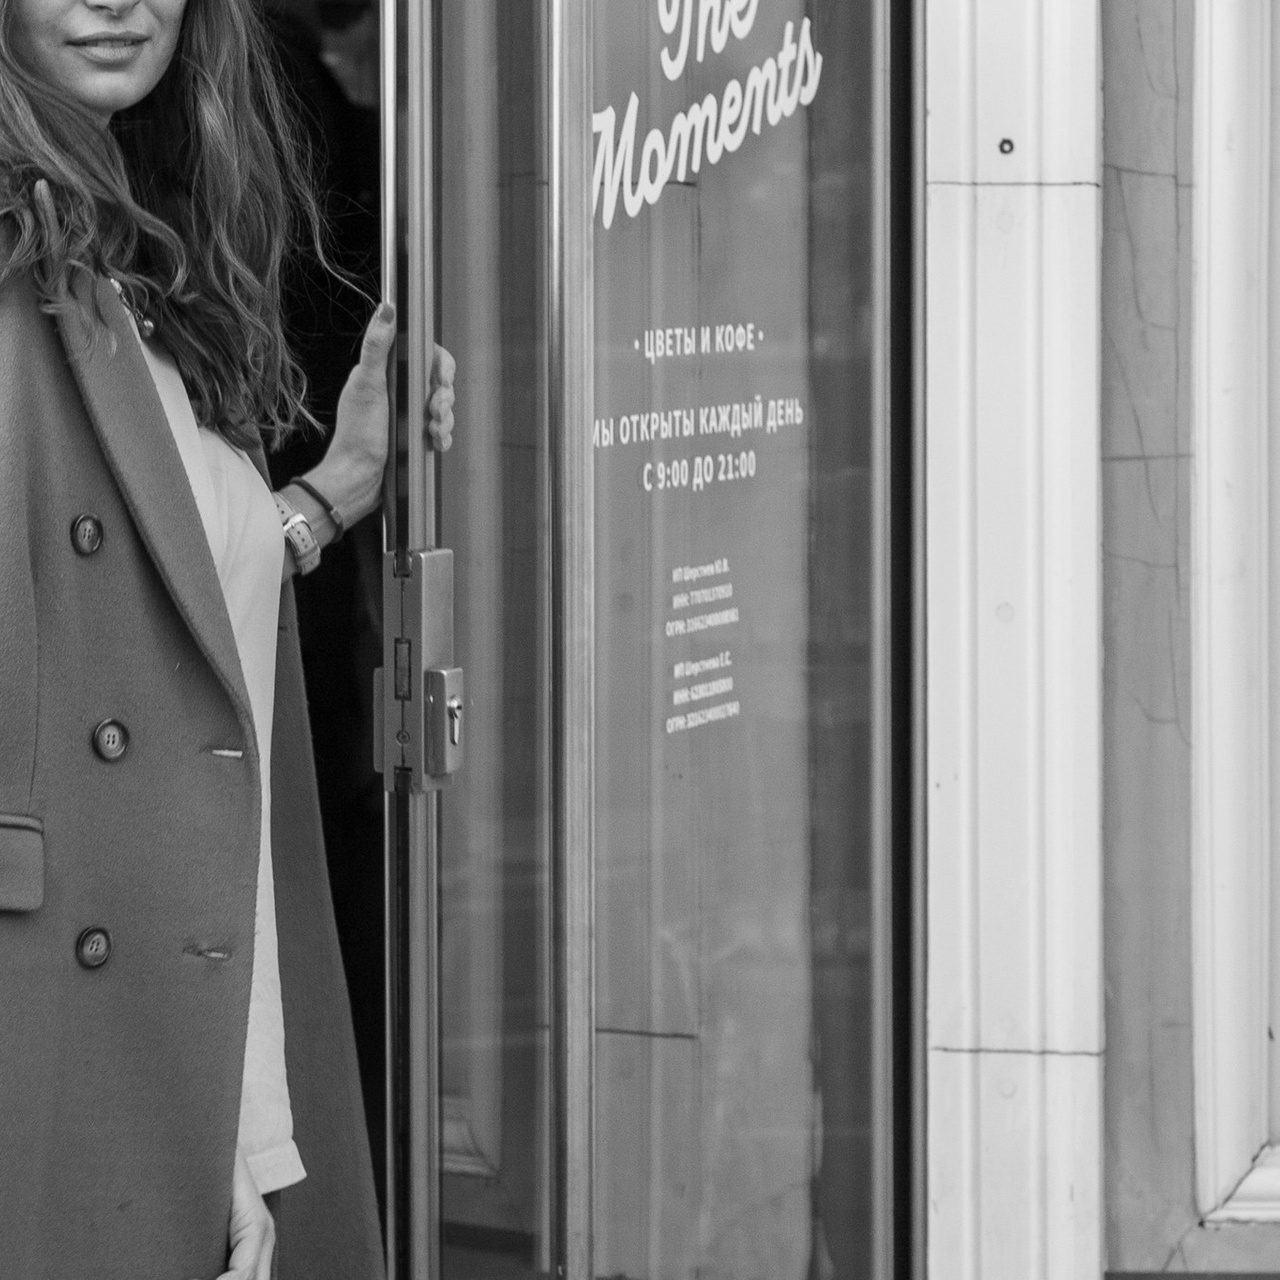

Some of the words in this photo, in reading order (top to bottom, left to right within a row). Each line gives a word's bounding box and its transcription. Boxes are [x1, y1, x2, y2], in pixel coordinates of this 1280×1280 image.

[593, 16, 823, 230] Moments
[644, 326, 696, 365] ЦВЕТЫ
[701, 325, 710, 354] И
[715, 322, 755, 353] КОФЕ
[620, 408, 695, 445] ОТКРЫТЫ
[699, 394, 763, 438] КАЖДЫЙ
[766, 397, 803, 434] ДЕНЬ
[643, 462, 652, 492] С
[657, 459, 689, 490] 9:00
[692, 455, 714, 492] ДО
[717, 450, 756, 481] 21:00
